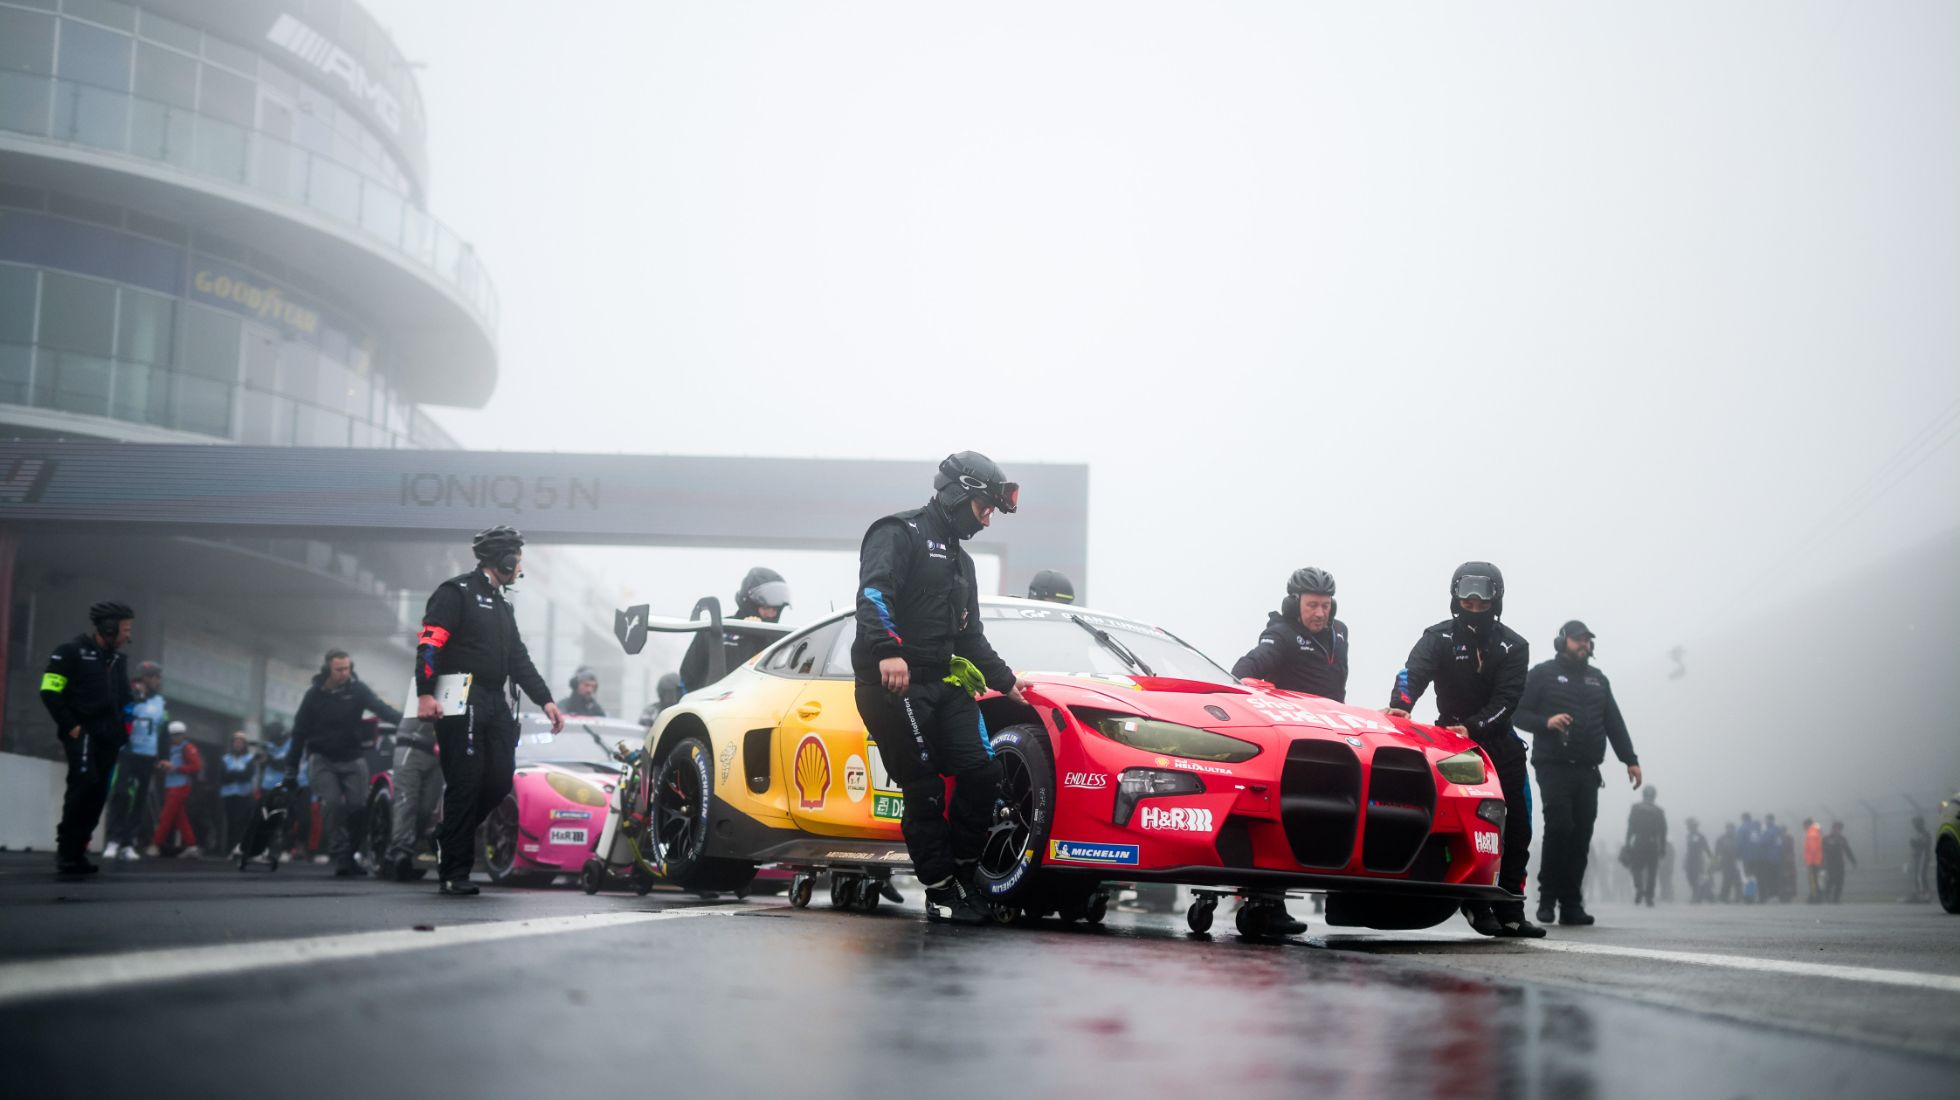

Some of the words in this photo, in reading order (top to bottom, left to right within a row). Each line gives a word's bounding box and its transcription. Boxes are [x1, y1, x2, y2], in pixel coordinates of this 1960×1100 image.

[194, 270, 319, 334] GOODYEAR
[400, 473, 524, 514] IONIQ
[535, 476, 559, 510] 5
[567, 477, 599, 511] N
[904, 697, 921, 735] Motorsport
[1064, 772, 1108, 787] ENDLESS
[1174, 762, 1206, 772] HELIX
[1204, 766, 1232, 775] ULTRA
[698, 760, 710, 818] MICHELIN
[1141, 807, 1190, 830] H&R
[1071, 847, 1131, 859] MICHELIN
[991, 867, 1024, 894] MICHELIN
